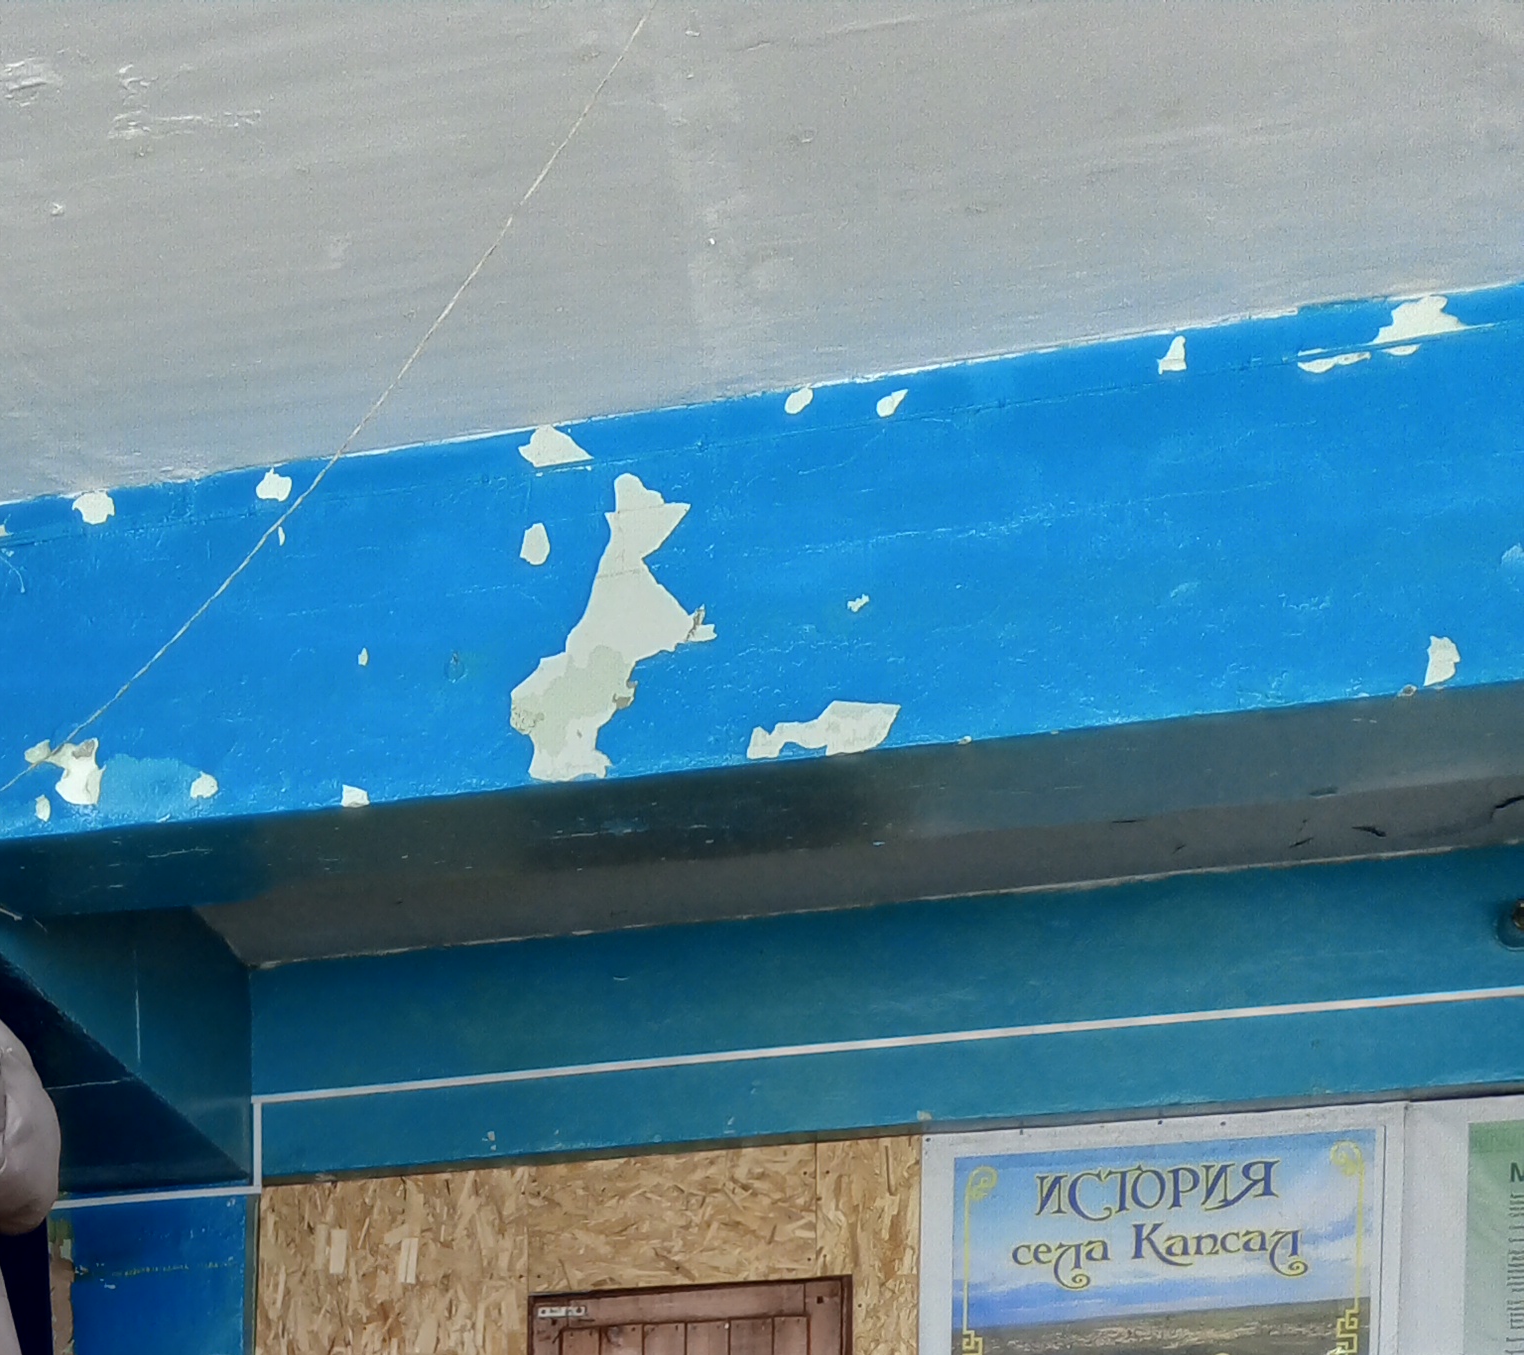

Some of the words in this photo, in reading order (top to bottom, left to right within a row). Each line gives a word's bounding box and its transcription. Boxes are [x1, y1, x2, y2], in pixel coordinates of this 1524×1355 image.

[1035, 1159, 1280, 1221] ИСТОРИЯ
[1011, 1238, 1111, 1290] села
[1131, 1222, 1309, 1277] Капсал
